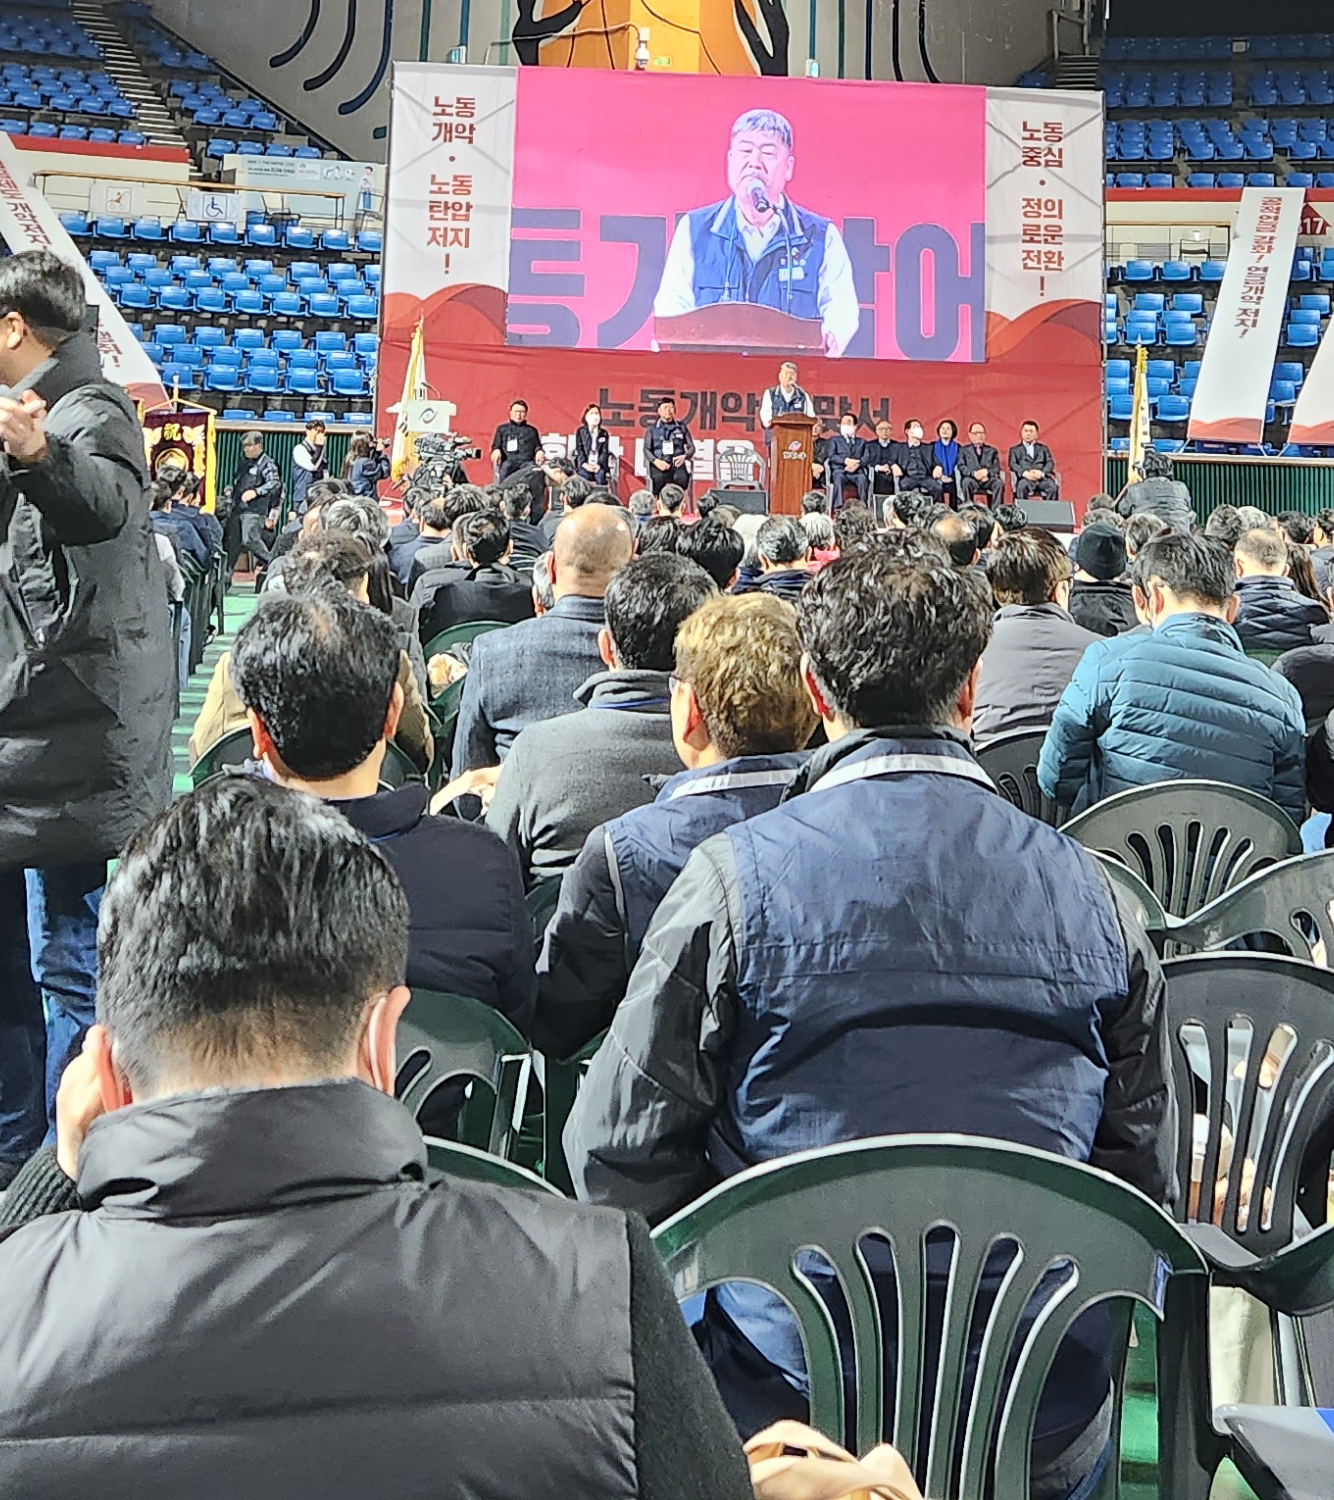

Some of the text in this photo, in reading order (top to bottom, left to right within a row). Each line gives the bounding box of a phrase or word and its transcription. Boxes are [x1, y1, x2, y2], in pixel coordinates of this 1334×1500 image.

[431, 96, 476, 118] 노동
[431, 122, 476, 144] 개악
[1021, 120, 1064, 143] 노동
[1021, 146, 1064, 168] 중심
[429, 174, 473, 196] 노동
[428, 200, 473, 222] 탄압
[1021, 198, 1064, 220] 정의
[1021, 223, 1064, 246] 로운
[1298, 217, 1324, 235] 17
[426, 227, 470, 248] 저지
[1250, 235, 1277, 264] 강화!
[1021, 250, 1065, 272] 전환
[1240, 266, 1270, 305] 연금개악
[1234, 307, 1261, 339] 저지!
[598, 387, 762, 433] 노동개악
